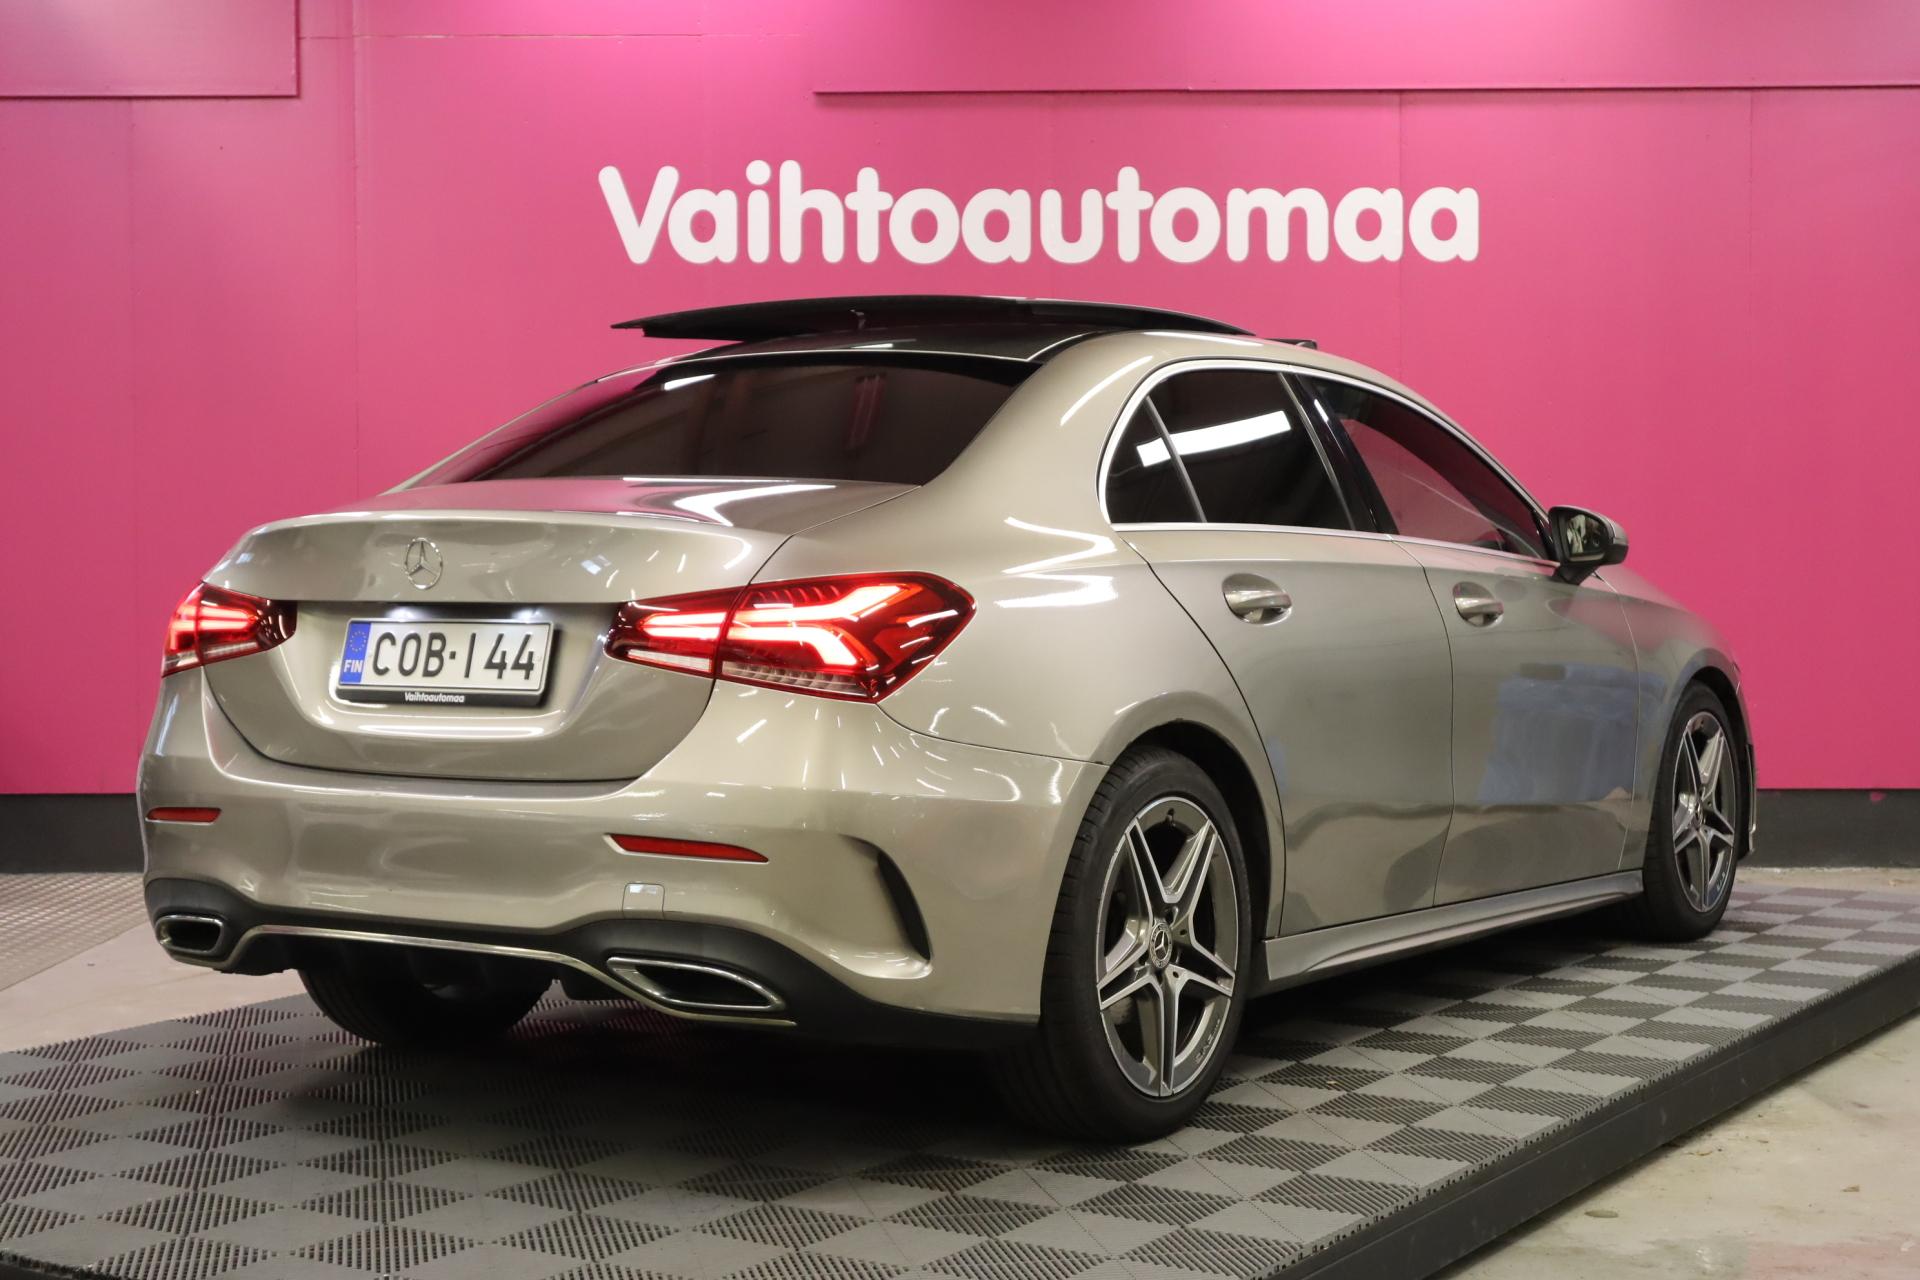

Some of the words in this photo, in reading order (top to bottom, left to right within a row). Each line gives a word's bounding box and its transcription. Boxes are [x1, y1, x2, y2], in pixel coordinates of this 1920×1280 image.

[598, 159, 1479, 264] Vaihtoautomaa
[343, 659, 364, 673] FIN
[404, 691, 465, 703] Vaihtoautomaa
